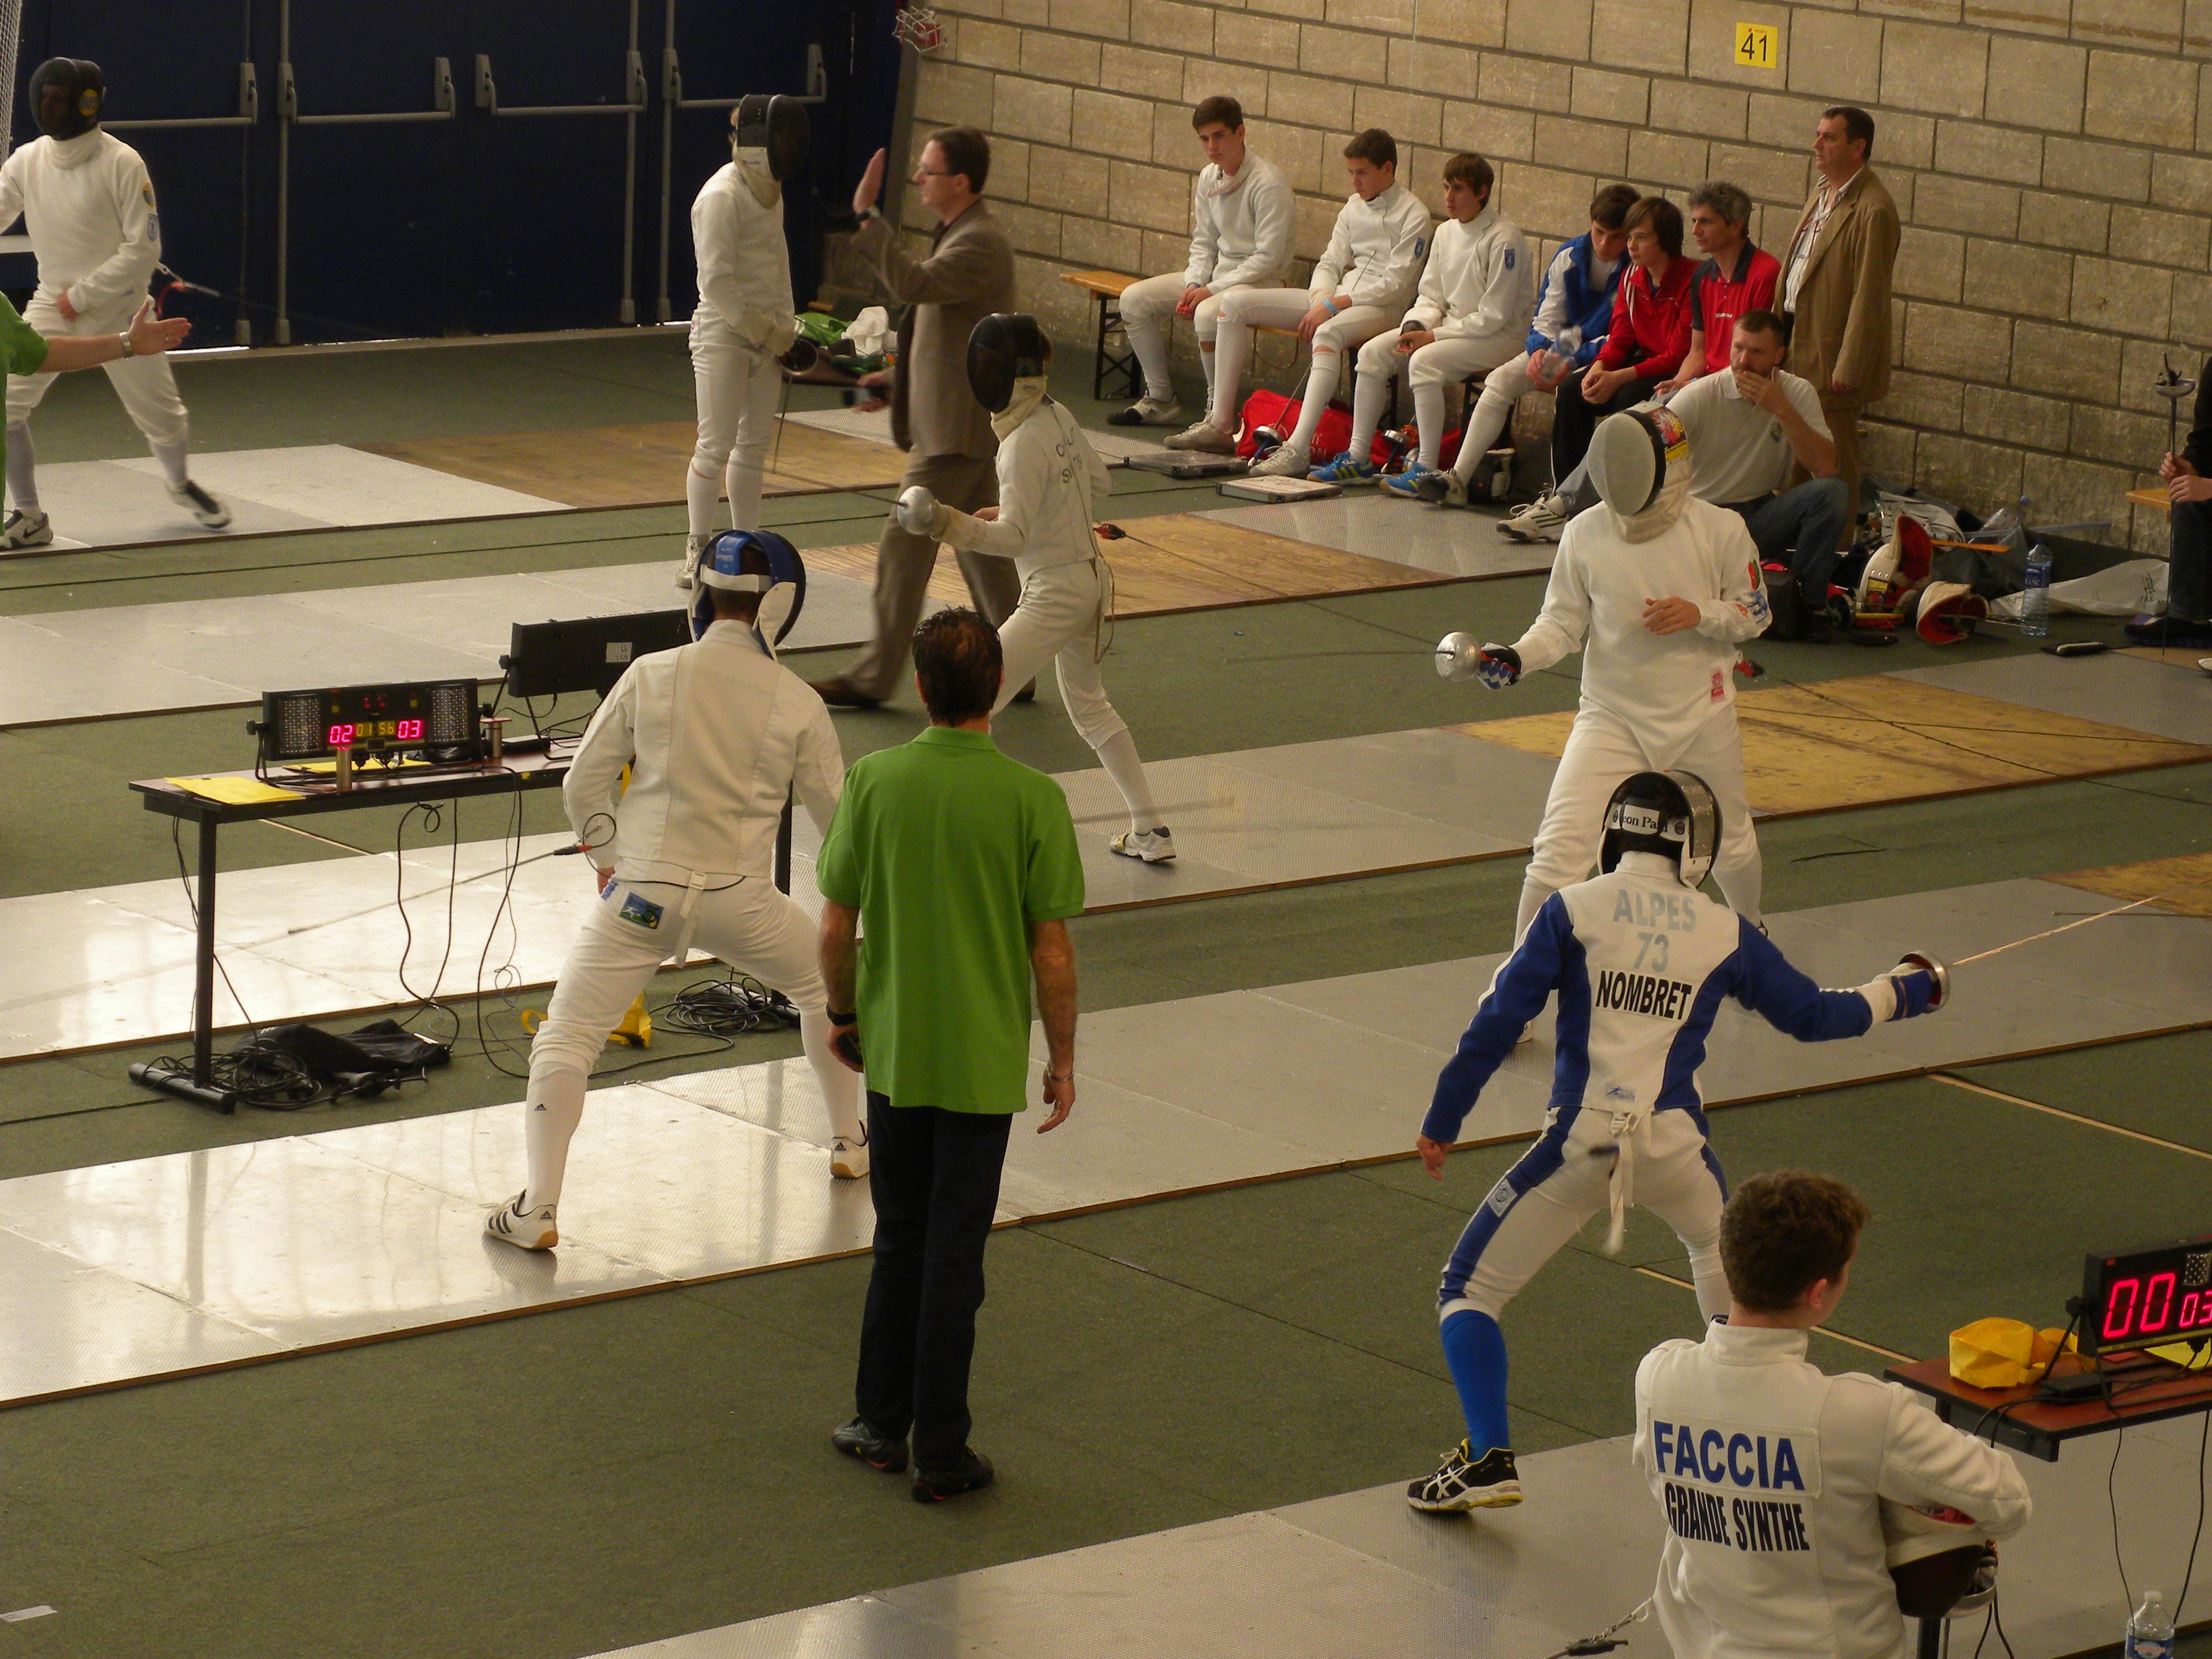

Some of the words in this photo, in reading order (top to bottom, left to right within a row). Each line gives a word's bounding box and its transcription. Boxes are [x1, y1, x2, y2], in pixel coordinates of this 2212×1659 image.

[1741, 33, 1767, 61] 41
[329, 724, 353, 744] 02
[356, 723, 372, 737] 01
[397, 719, 421, 739] 03
[1641, 816, 1668, 832] Pal
[1613, 889, 1697, 932] ALPES
[1633, 932, 1670, 973] 73
[1595, 971, 1692, 1020] NOMBRET
[2103, 1272, 2176, 1338] 00
[1654, 1420, 1805, 1490] FACCIA
[1665, 1481, 1731, 1547] GRANDE
[1733, 1497, 1811, 1551] SYNTHE
